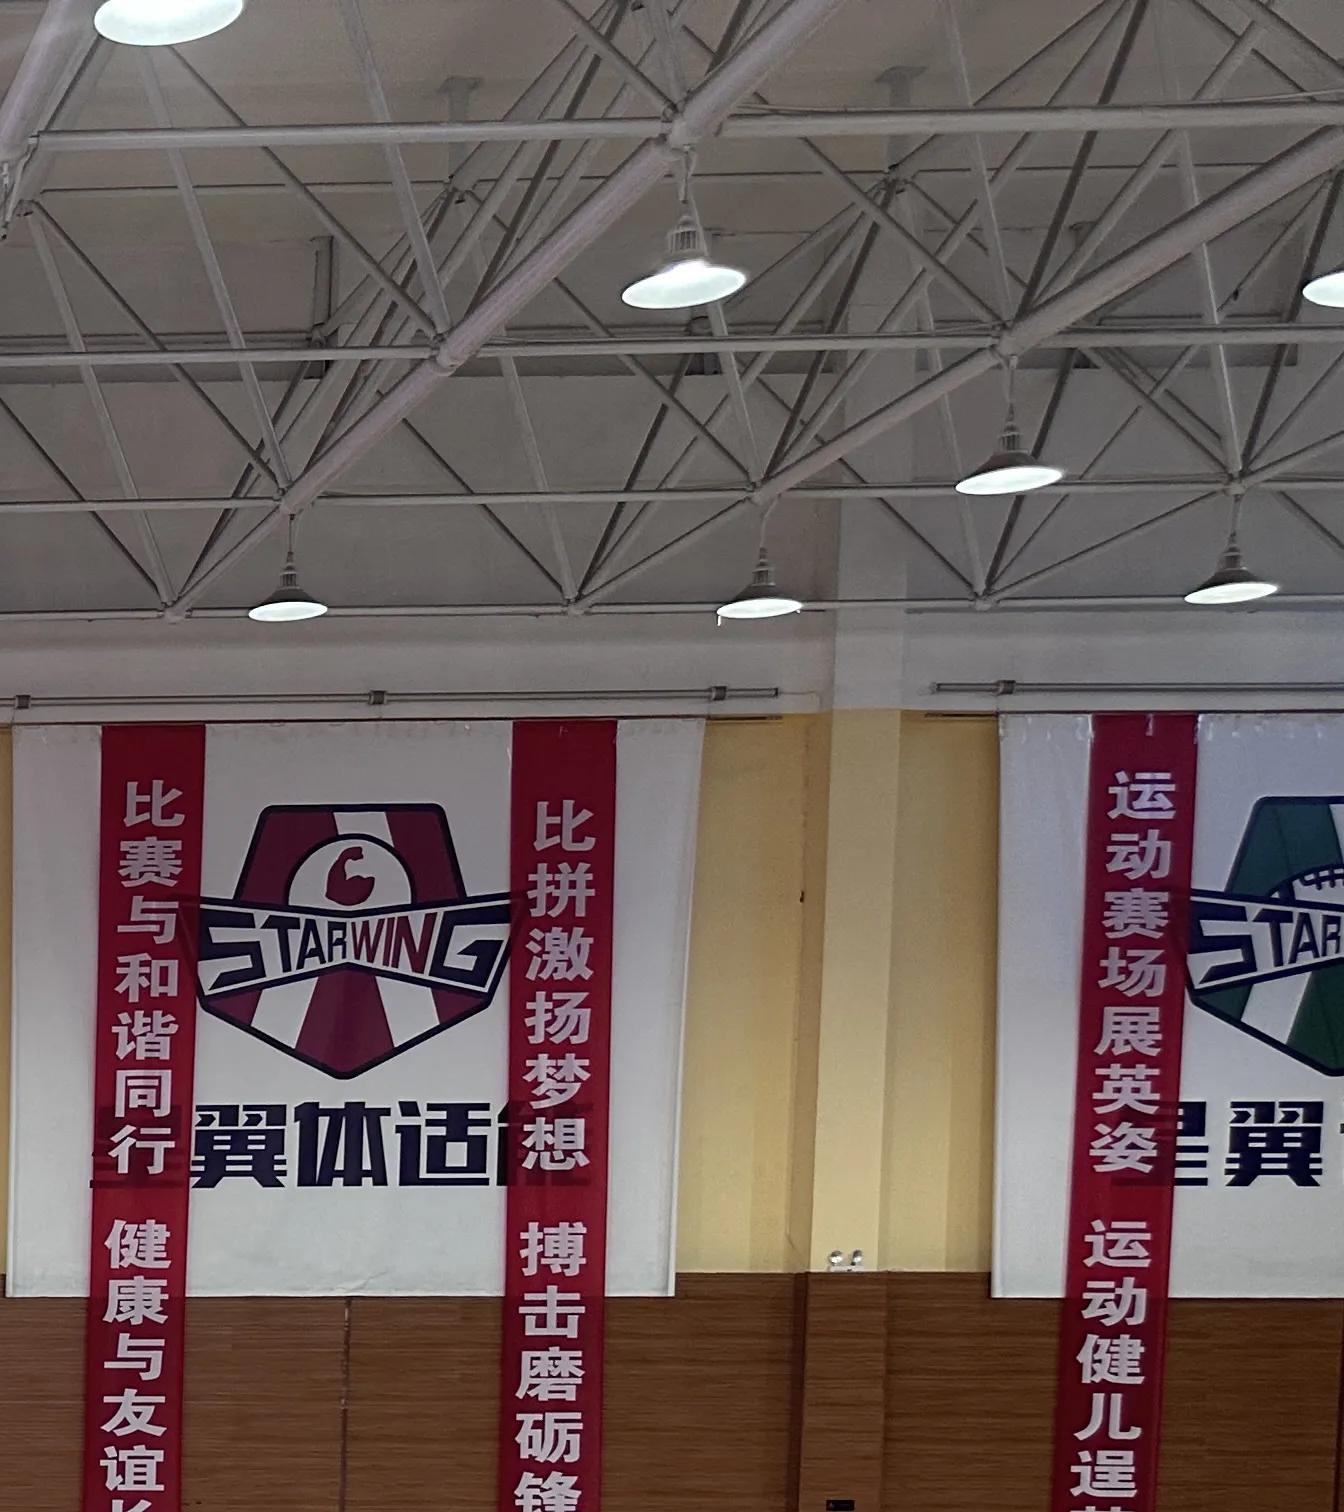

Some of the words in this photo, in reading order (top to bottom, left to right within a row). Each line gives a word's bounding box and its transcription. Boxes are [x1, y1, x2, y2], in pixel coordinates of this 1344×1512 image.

[109, 780, 185, 1175] 比赛与和谐同行
[199, 904, 510, 990] STARWING
[520, 799, 597, 1171] 比拼激扬梦想
[1089, 770, 1176, 1173] 运动赛场展英姿
